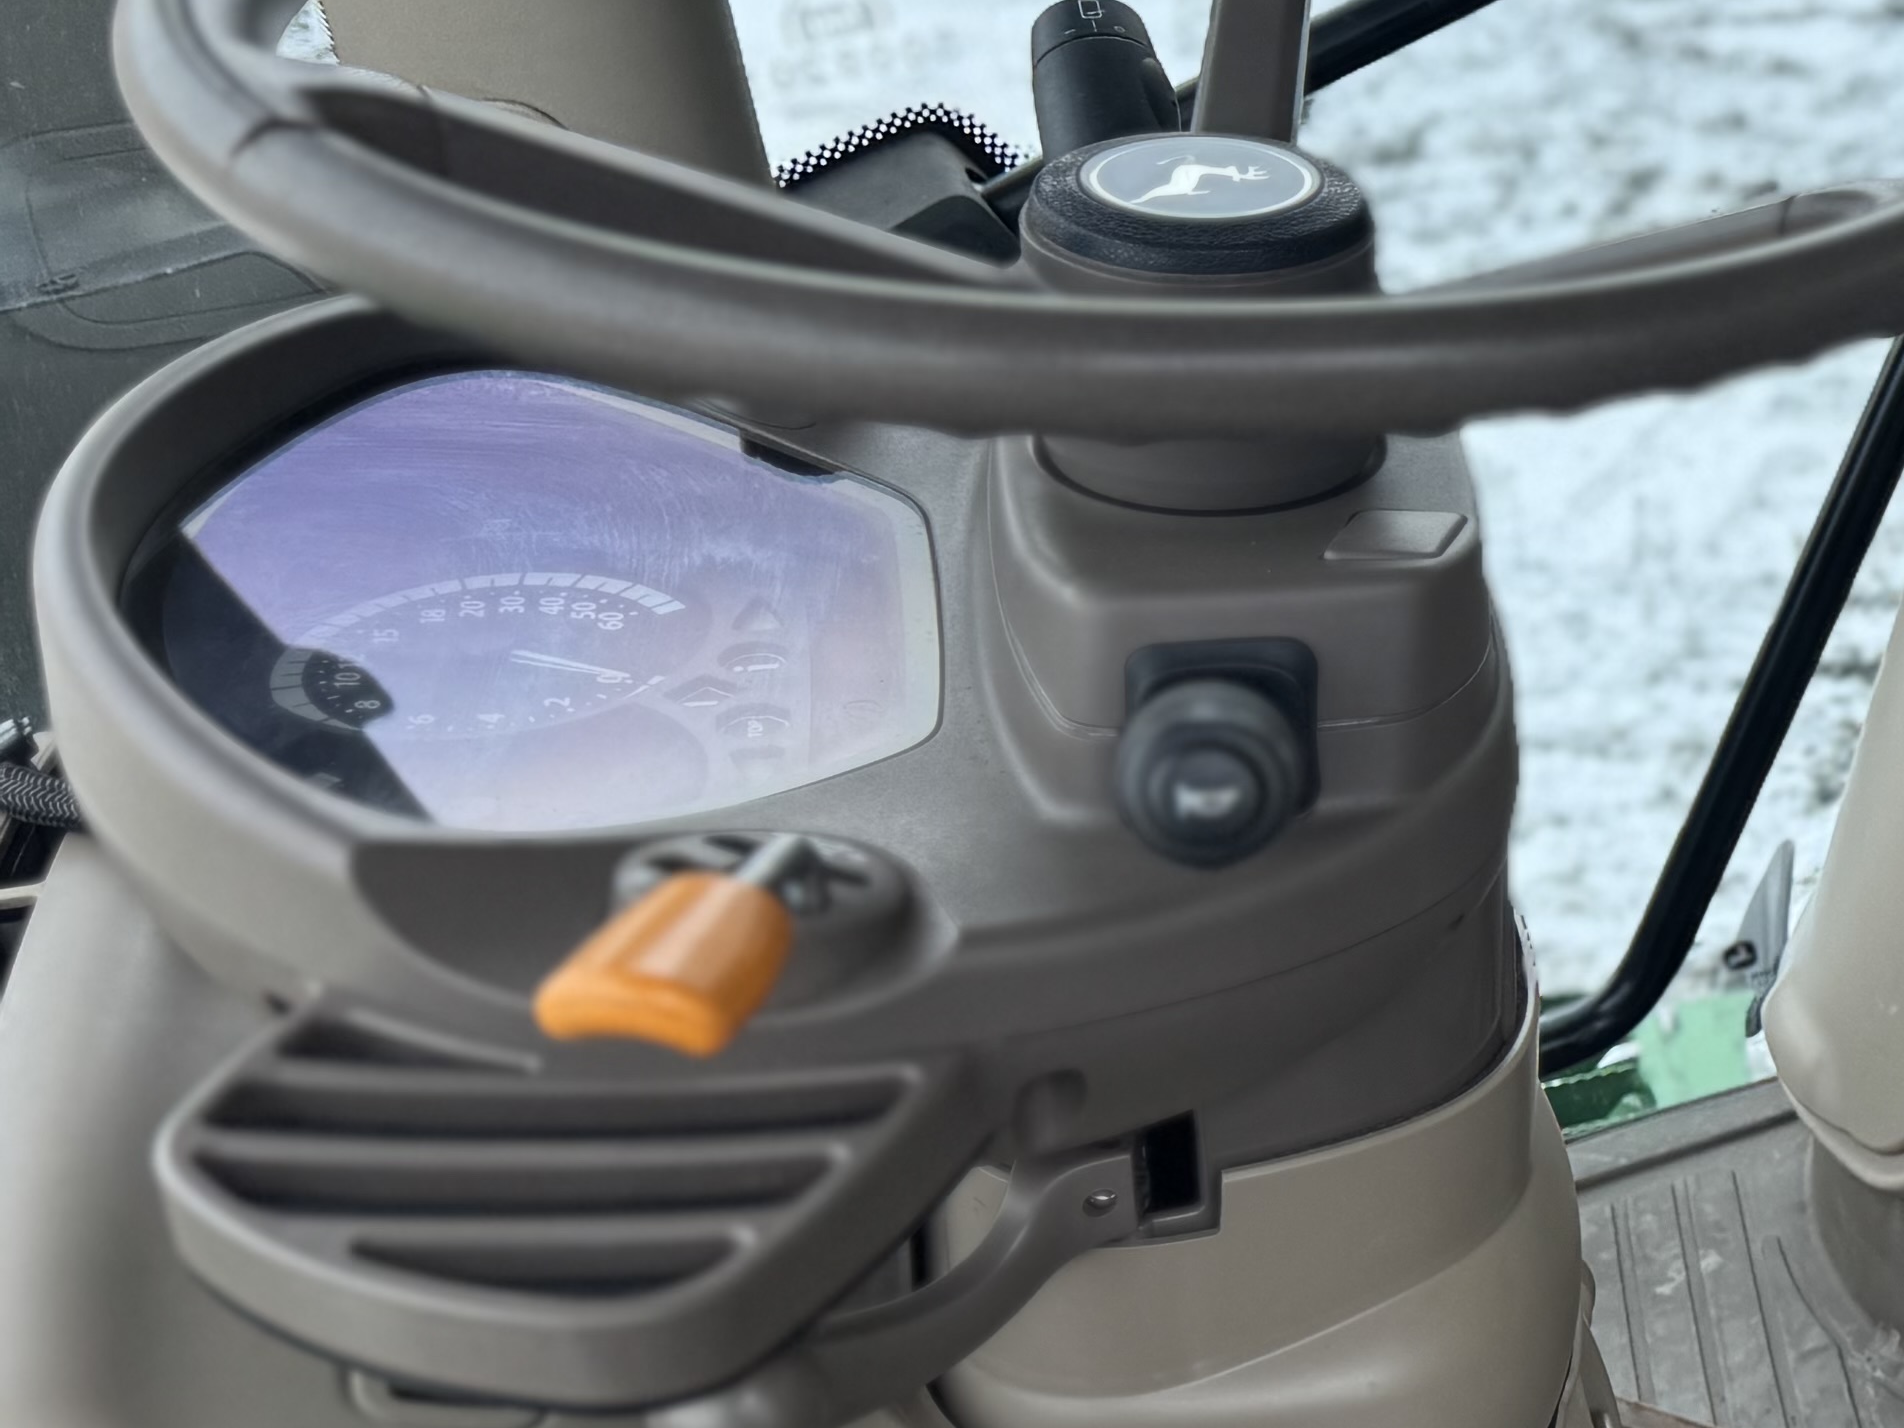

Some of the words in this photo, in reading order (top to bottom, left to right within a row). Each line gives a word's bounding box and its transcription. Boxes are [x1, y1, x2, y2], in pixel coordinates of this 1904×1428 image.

[459, 599, 486, 617] 20
[500, 596, 525, 613] 30
[539, 596, 566, 615] 40
[571, 601, 597, 620] 50
[419, 609, 446, 623] 18
[597, 612, 624, 630] 60
[372, 628, 399, 644] 15
[333, 672, 361, 689] 10
[354, 699, 381, 710] 8
[543, 696, 571, 708] 2
[412, 713, 436, 724] 6
[477, 712, 505, 722] 4
